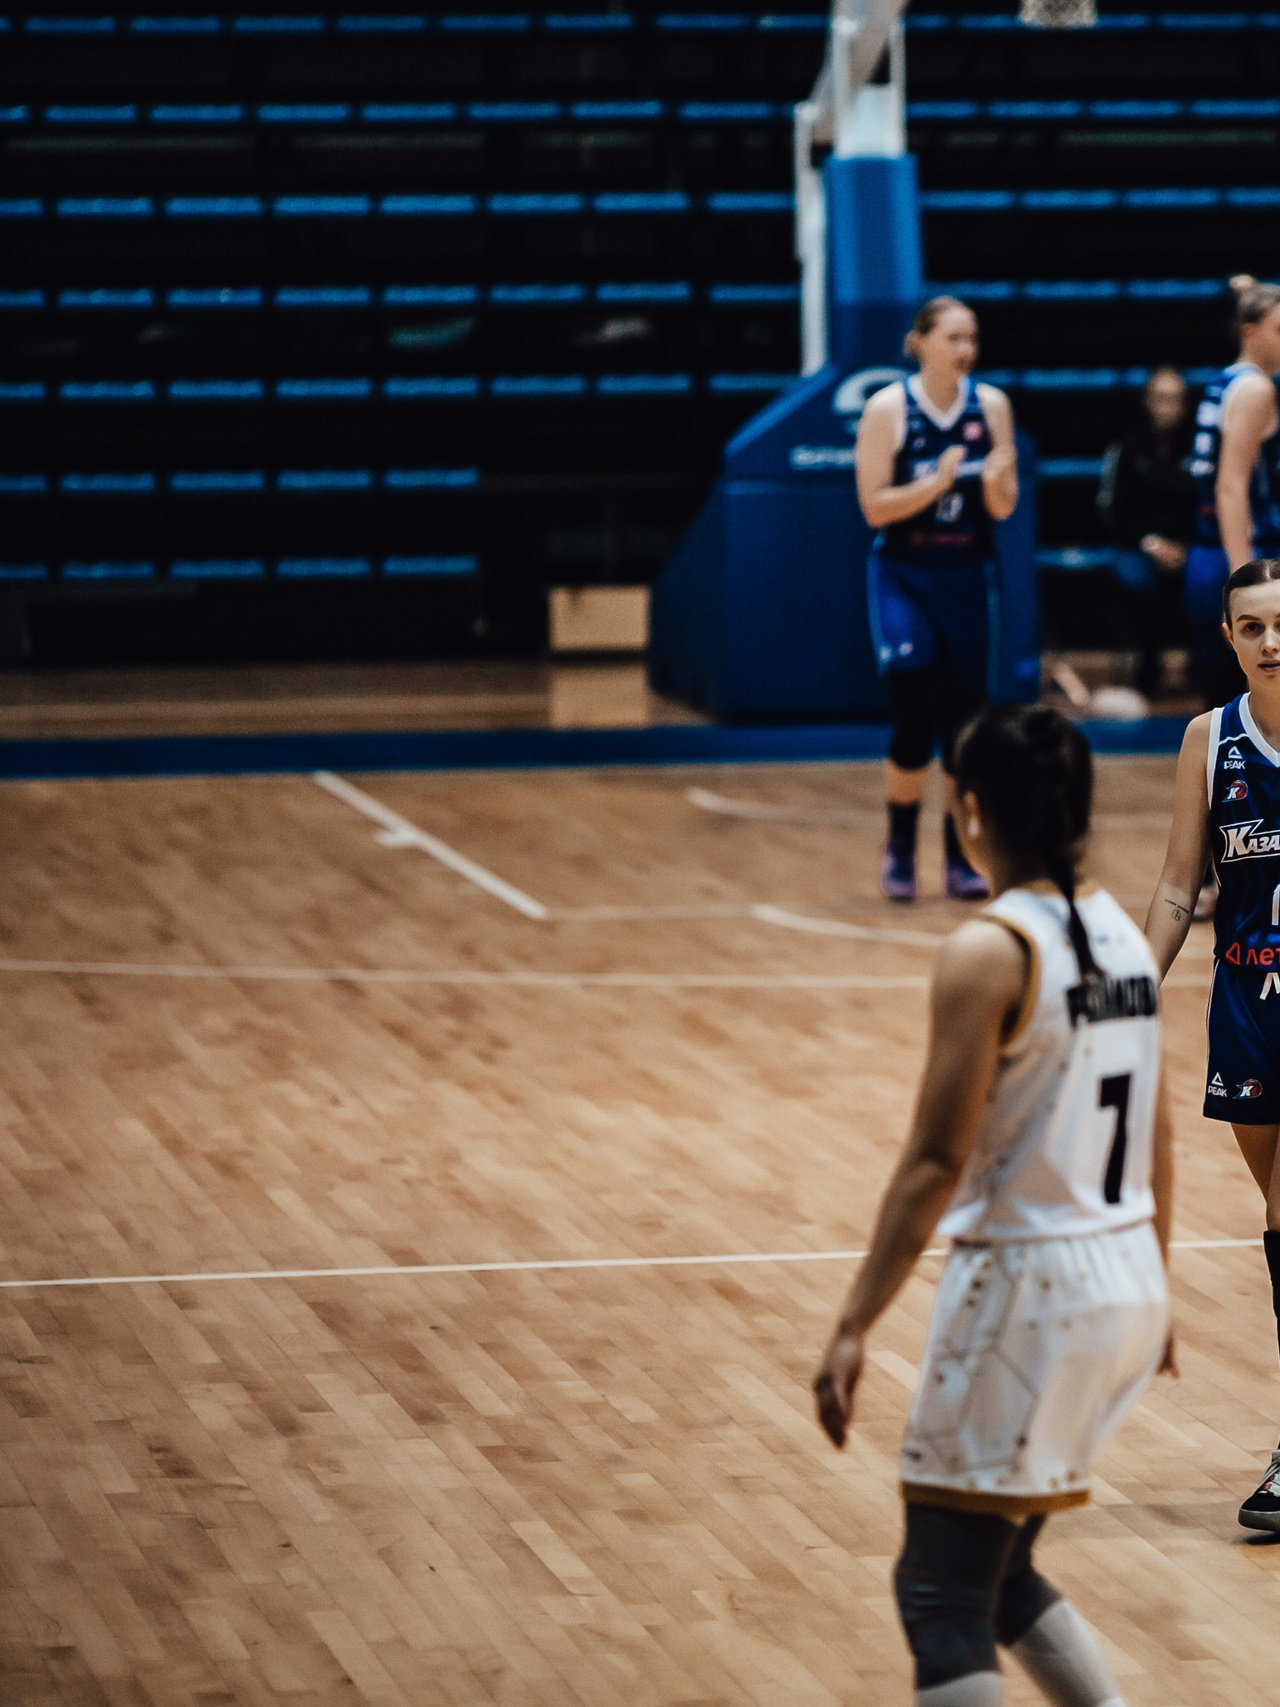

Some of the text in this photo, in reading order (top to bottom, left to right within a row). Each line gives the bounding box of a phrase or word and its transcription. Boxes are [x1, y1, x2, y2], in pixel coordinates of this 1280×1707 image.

[1223, 760, 1246, 770] PEAK
[1207, 1085, 1228, 1097] PEAK
[1100, 1073, 1132, 1204] 7
